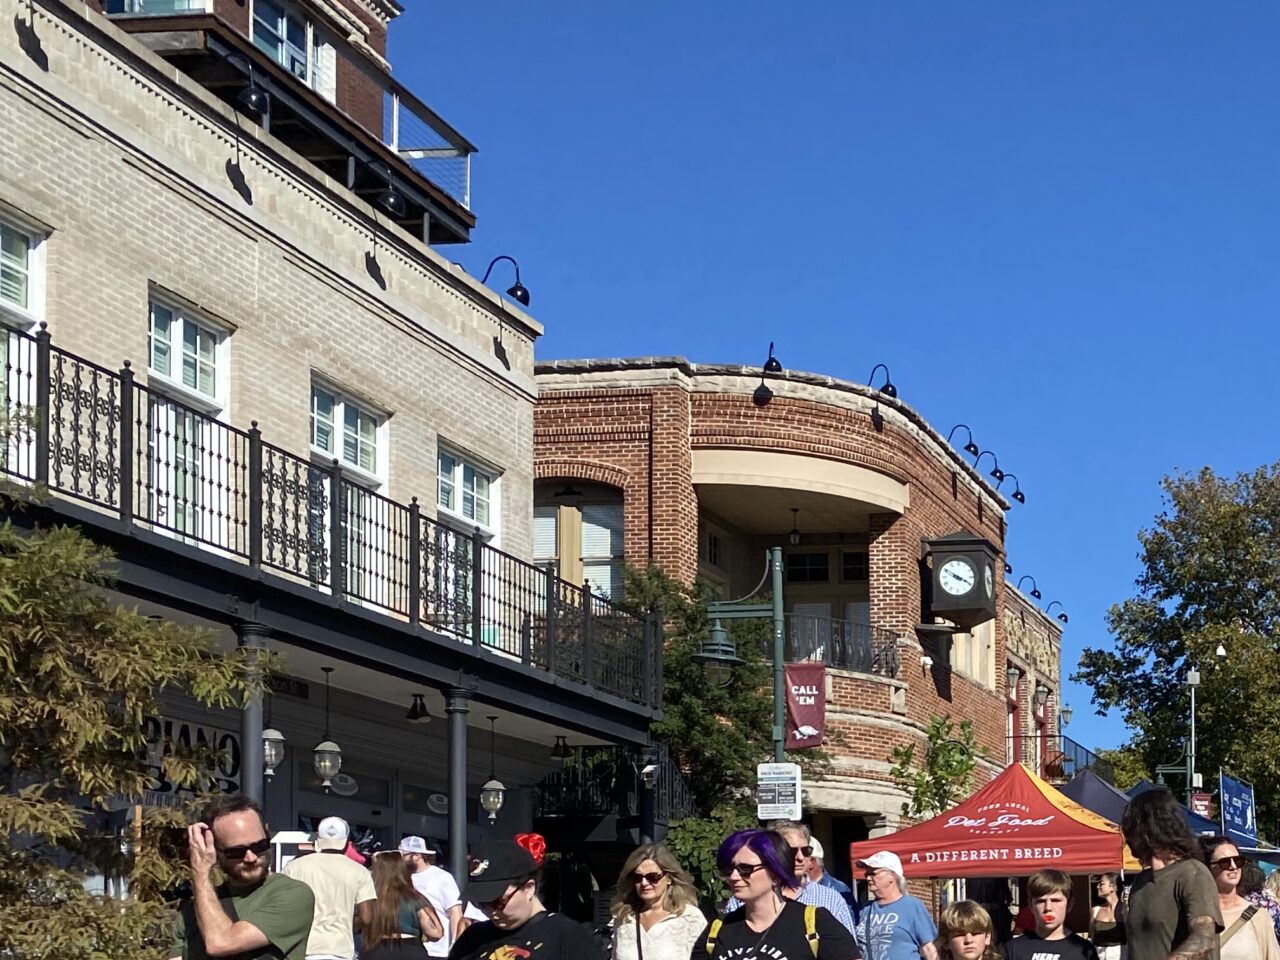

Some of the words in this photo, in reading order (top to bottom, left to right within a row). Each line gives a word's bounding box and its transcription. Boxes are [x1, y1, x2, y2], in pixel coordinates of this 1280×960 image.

[791, 685, 819, 695] CALL
[796, 696, 815, 705] 'EM
[943, 815, 986, 829] Pet
[987, 813, 1055, 829] Food
[911, 852, 921, 863] A
[926, 848, 1009, 863] DIFFERENT
[1014, 846, 1063, 860] BREED
